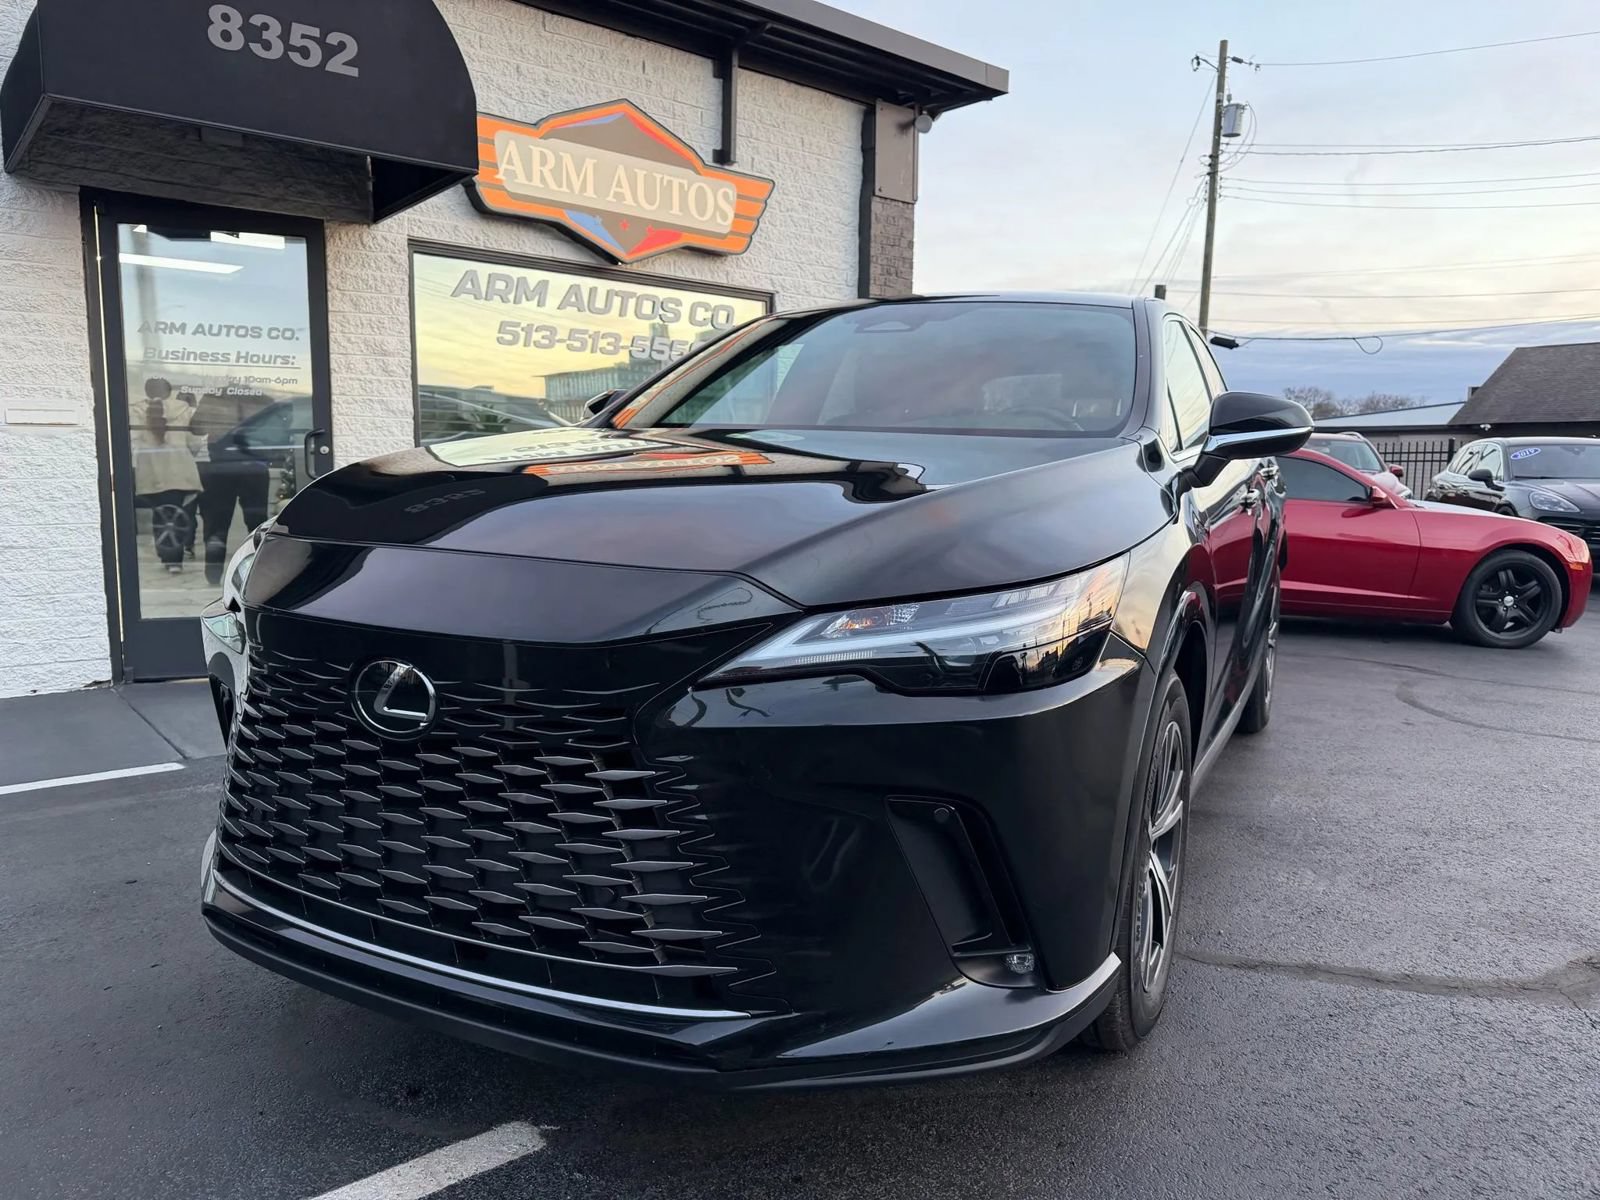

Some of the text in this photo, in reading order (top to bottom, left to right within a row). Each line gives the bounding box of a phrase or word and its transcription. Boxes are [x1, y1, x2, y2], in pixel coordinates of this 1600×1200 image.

[207, 4, 359, 78] 8352
[495, 140, 735, 226] ARM AUTOS
[450, 269, 549, 309] ARM
[558, 283, 683, 324] AUTOS
[137, 320, 300, 341] ARM AUTOS CO.
[143, 346, 296, 366] Business Hours:
[244, 376, 298, 386] 10am-6pm
